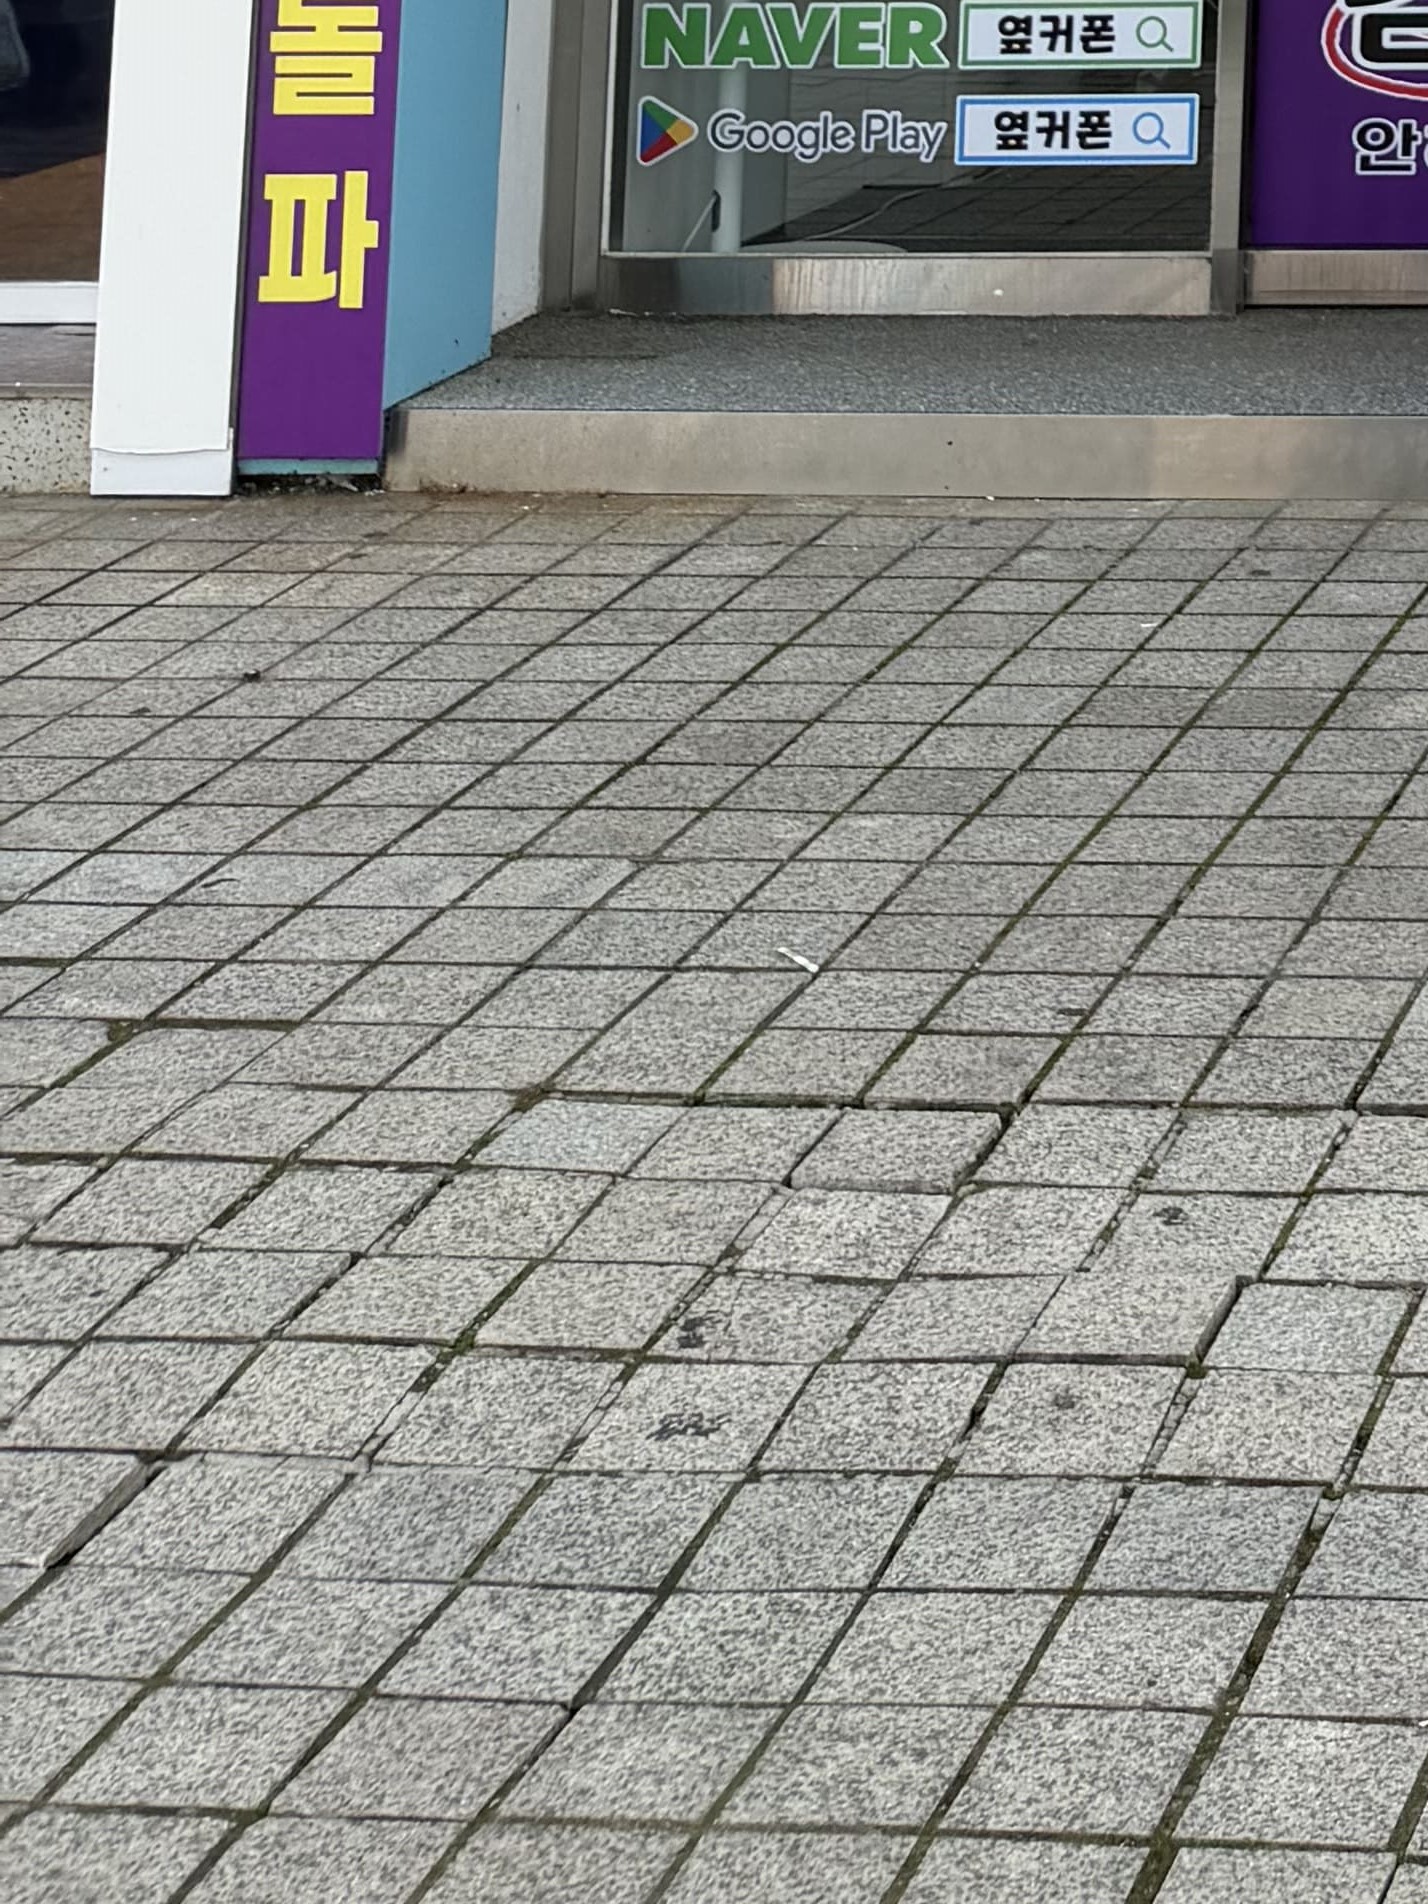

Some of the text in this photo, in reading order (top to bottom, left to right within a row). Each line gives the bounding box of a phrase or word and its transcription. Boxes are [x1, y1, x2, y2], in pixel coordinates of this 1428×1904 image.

[643, 4, 1116, 67] NAVER 옆커폰
[710, 111, 1112, 160] Google Play 옆커폰
